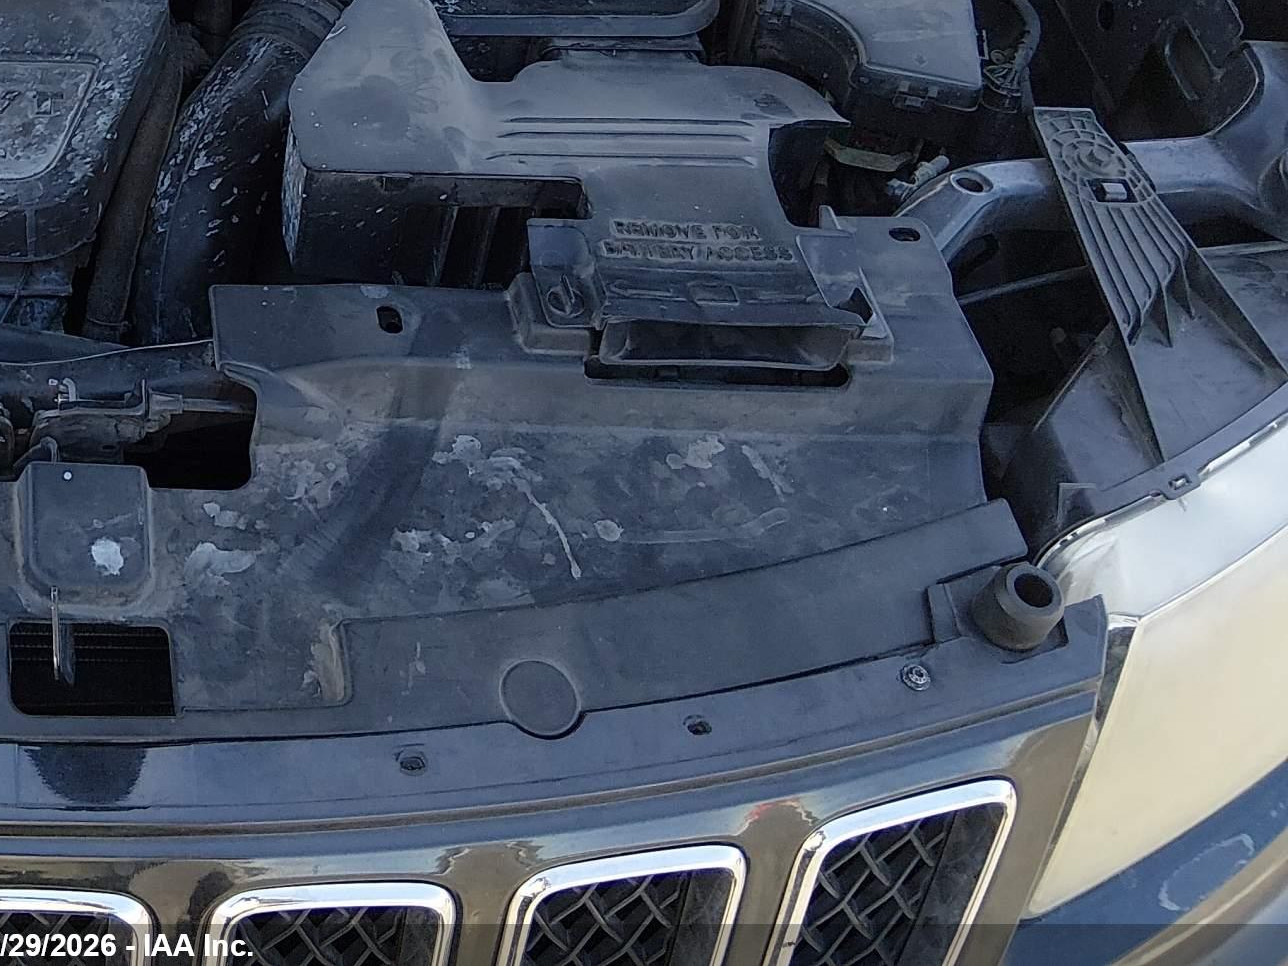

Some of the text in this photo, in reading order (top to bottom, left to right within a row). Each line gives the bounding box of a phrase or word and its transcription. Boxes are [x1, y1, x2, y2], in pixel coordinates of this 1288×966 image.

[613, 219, 760, 241] REMOVE FOR
[602, 240, 795, 262] BATTERY ACCESS
